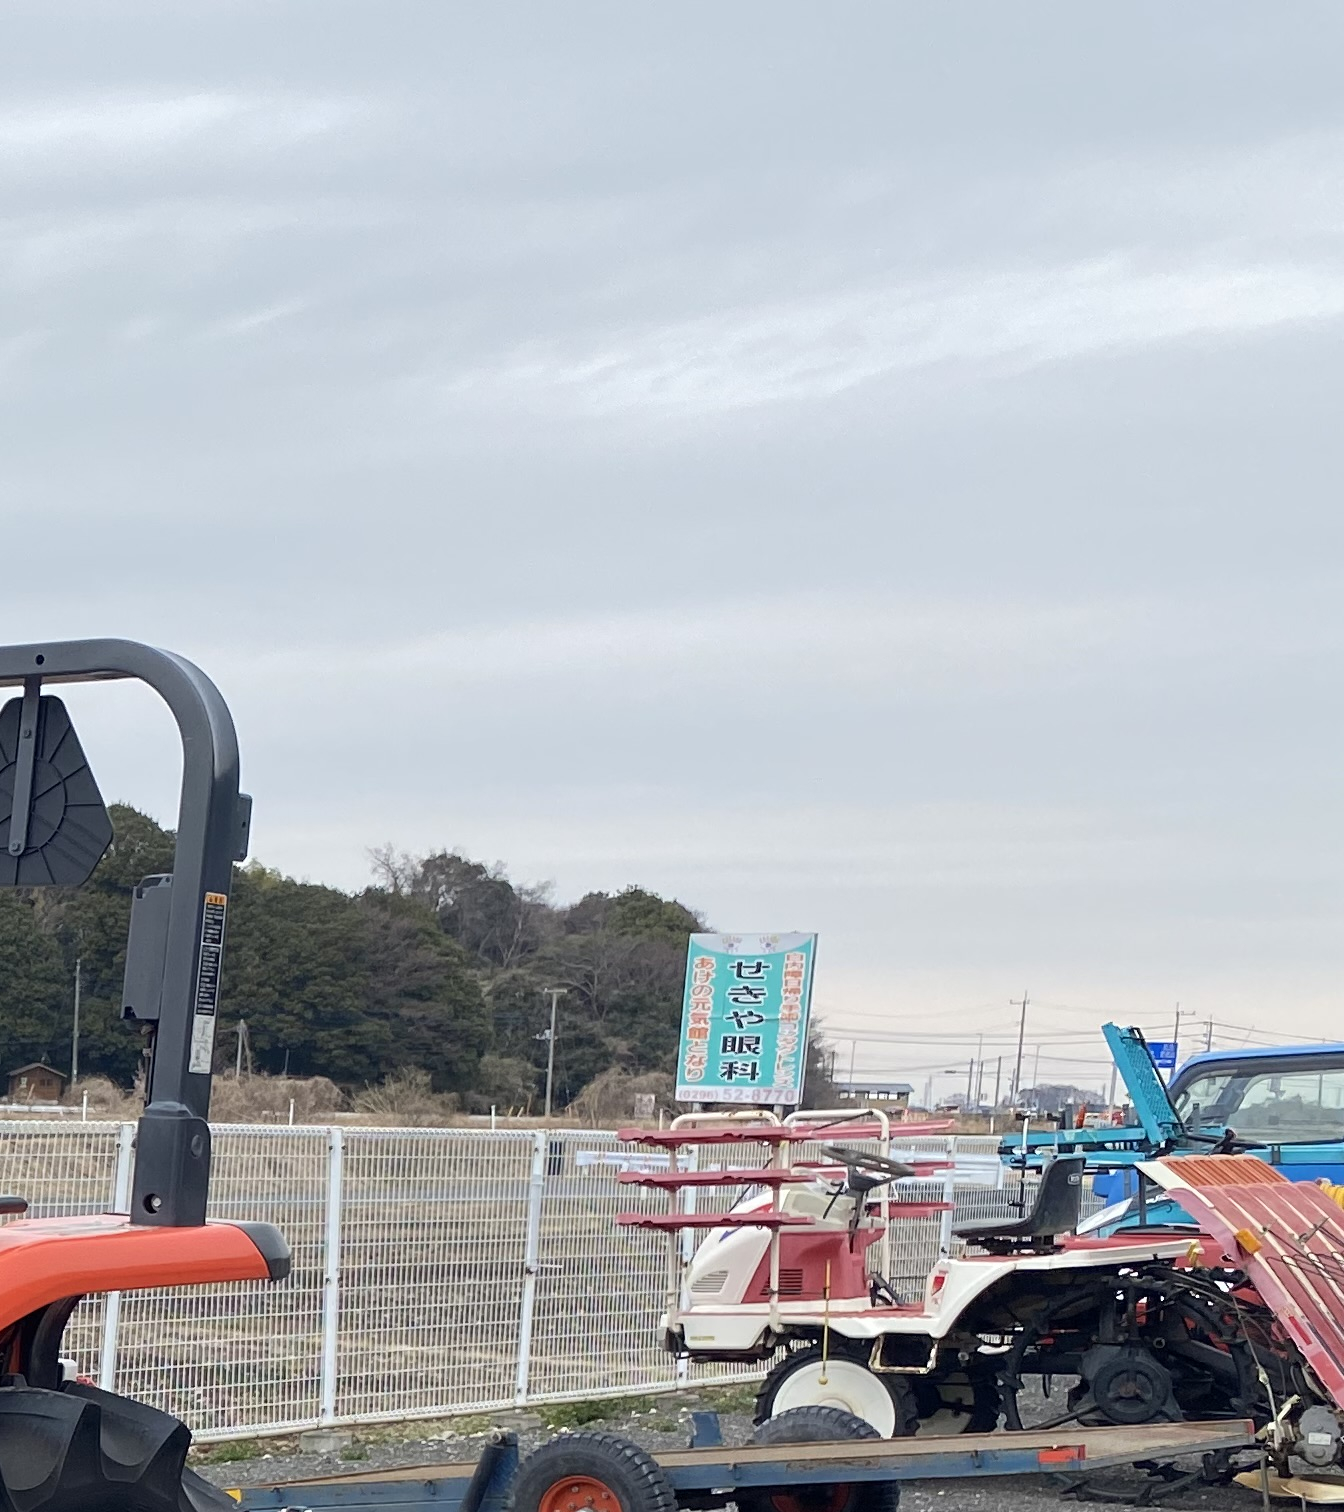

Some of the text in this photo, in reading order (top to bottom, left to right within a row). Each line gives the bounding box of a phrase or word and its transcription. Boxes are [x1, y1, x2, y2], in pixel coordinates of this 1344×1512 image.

[686, 957, 714, 1080] あけの元気館となり
[720, 961, 770, 1081] せきや眼科
